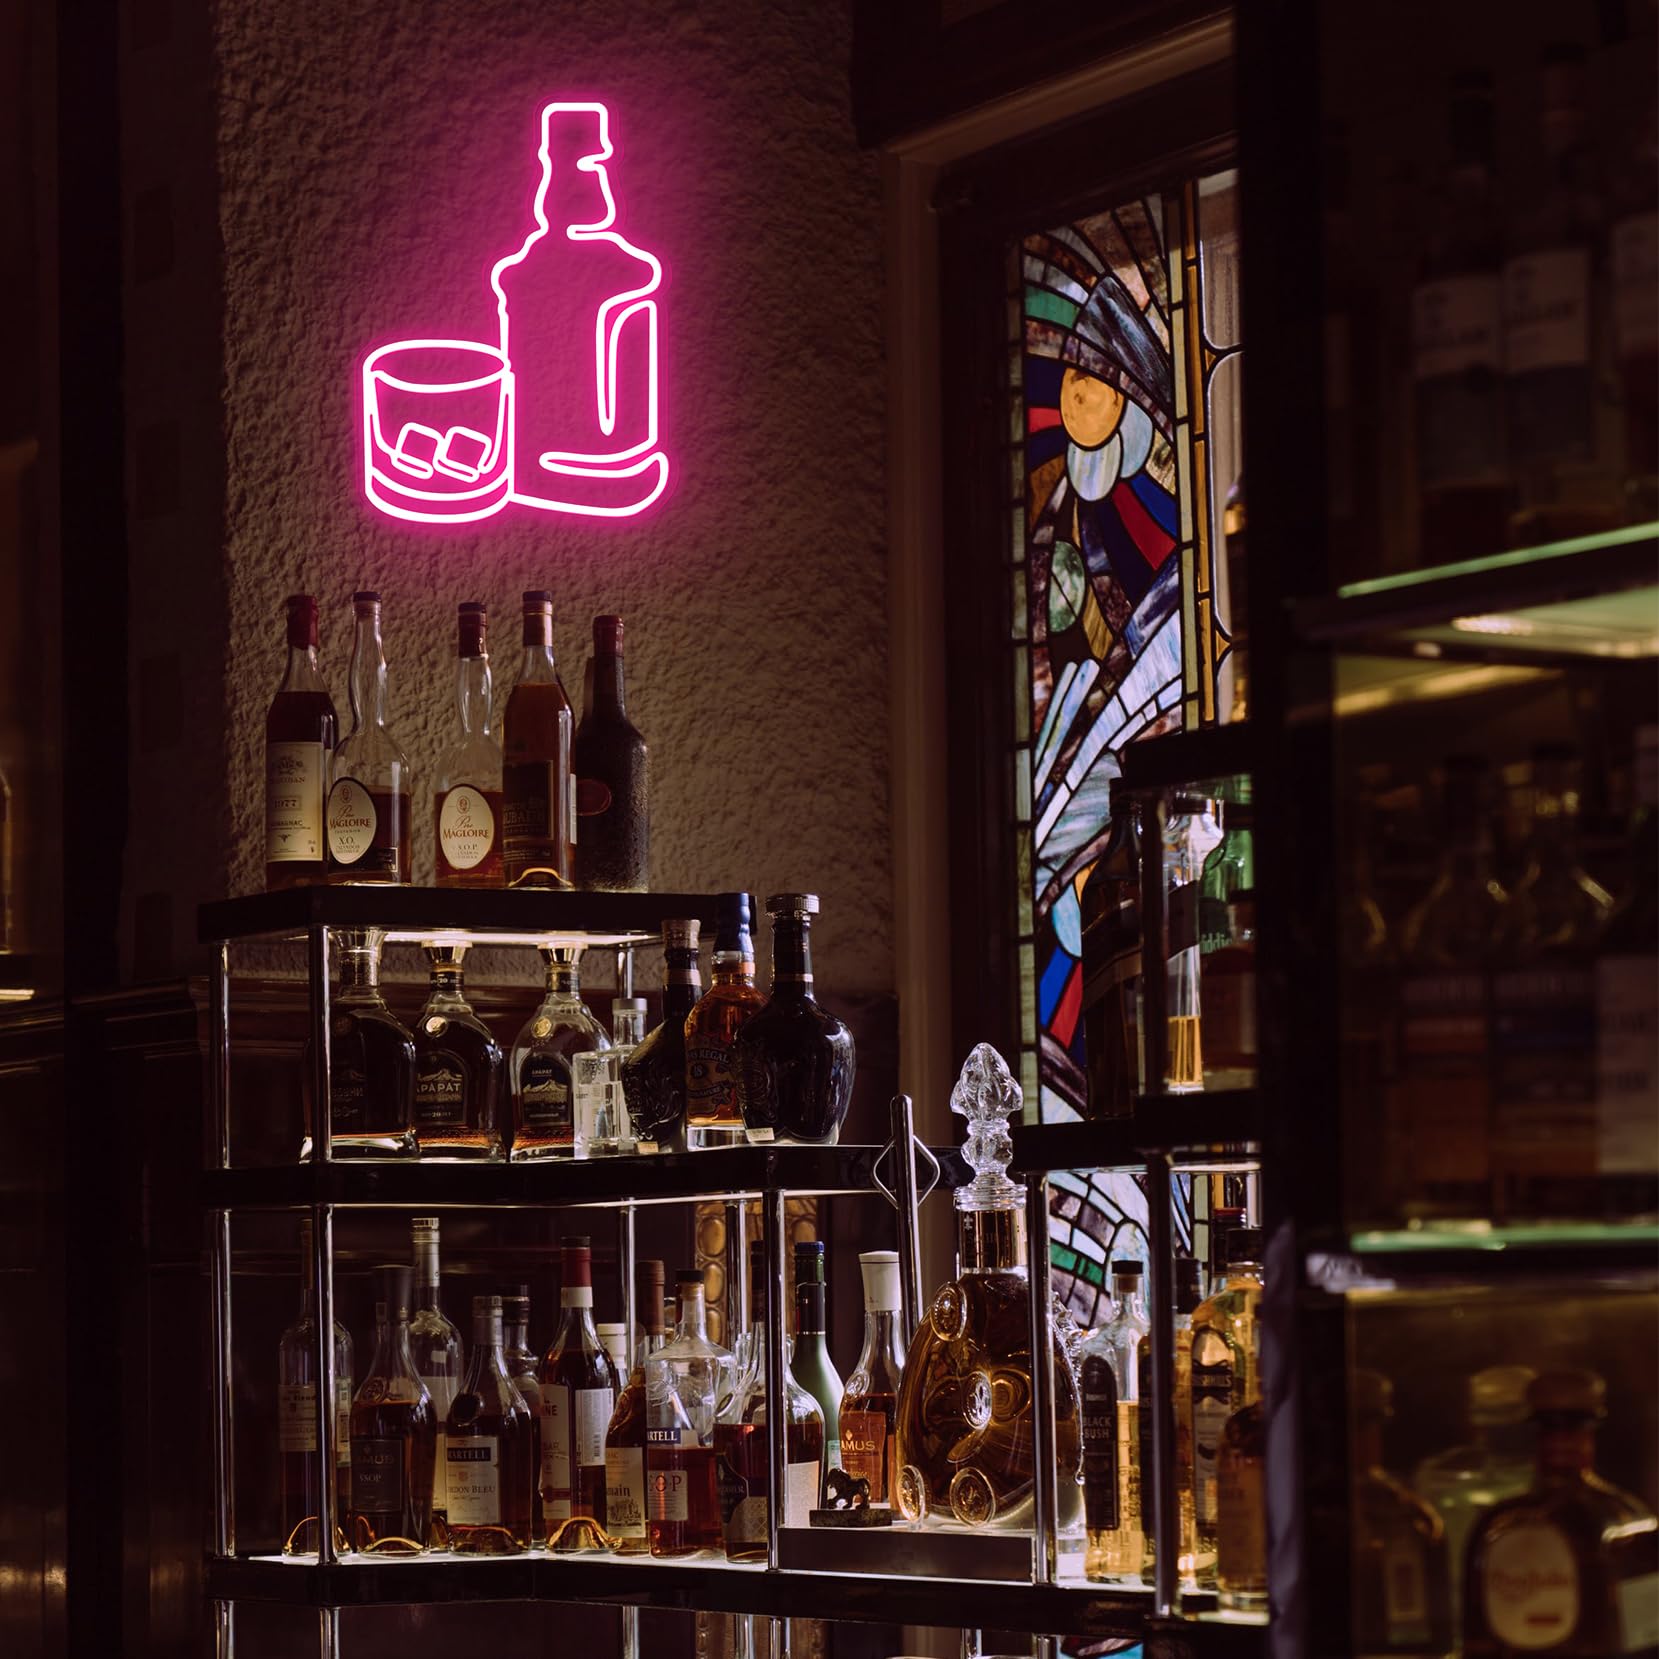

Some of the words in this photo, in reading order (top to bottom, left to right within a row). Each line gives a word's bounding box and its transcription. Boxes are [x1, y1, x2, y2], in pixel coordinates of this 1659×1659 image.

[275, 799, 297, 808] 1977
[330, 818, 371, 829] MAGLOIRE
[443, 828, 489, 840] MAGLOIRE
[699, 1049, 730, 1064] REGAL
[1082, 1416, 1112, 1427] BLACK
[1084, 1428, 1109, 1439] BUSH
[472, 1486, 497, 1494] BLEU
